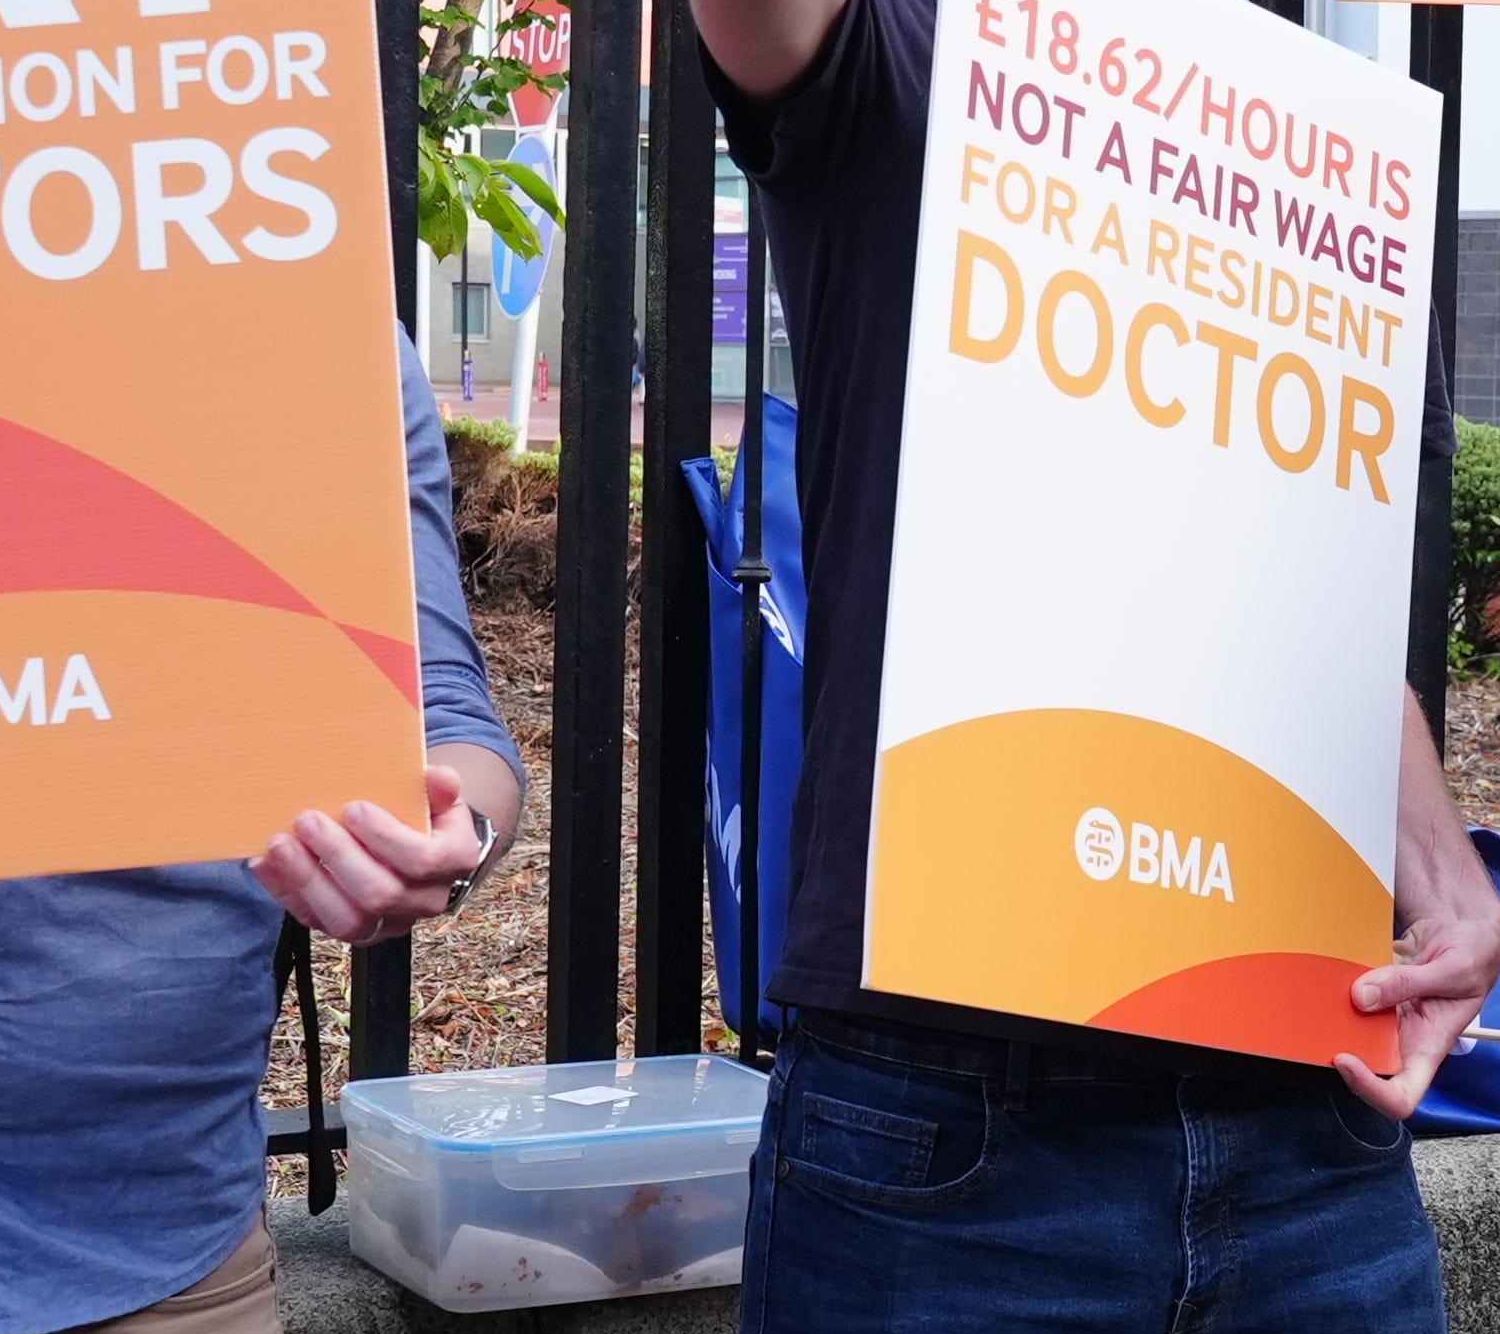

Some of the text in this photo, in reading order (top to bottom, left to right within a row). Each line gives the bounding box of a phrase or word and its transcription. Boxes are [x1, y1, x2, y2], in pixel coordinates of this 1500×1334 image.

[160, 32, 331, 111] FOR
[512, 13, 571, 65] STOP
[967, 59, 1407, 297] NOT A FAIR WAGE
[1368, 151, 1412, 221] IS
[960, 143, 1403, 368] FOR A RESIDENT
[948, 228, 1395, 505] DOCTOR
[1128, 821, 1235, 903] BMA
